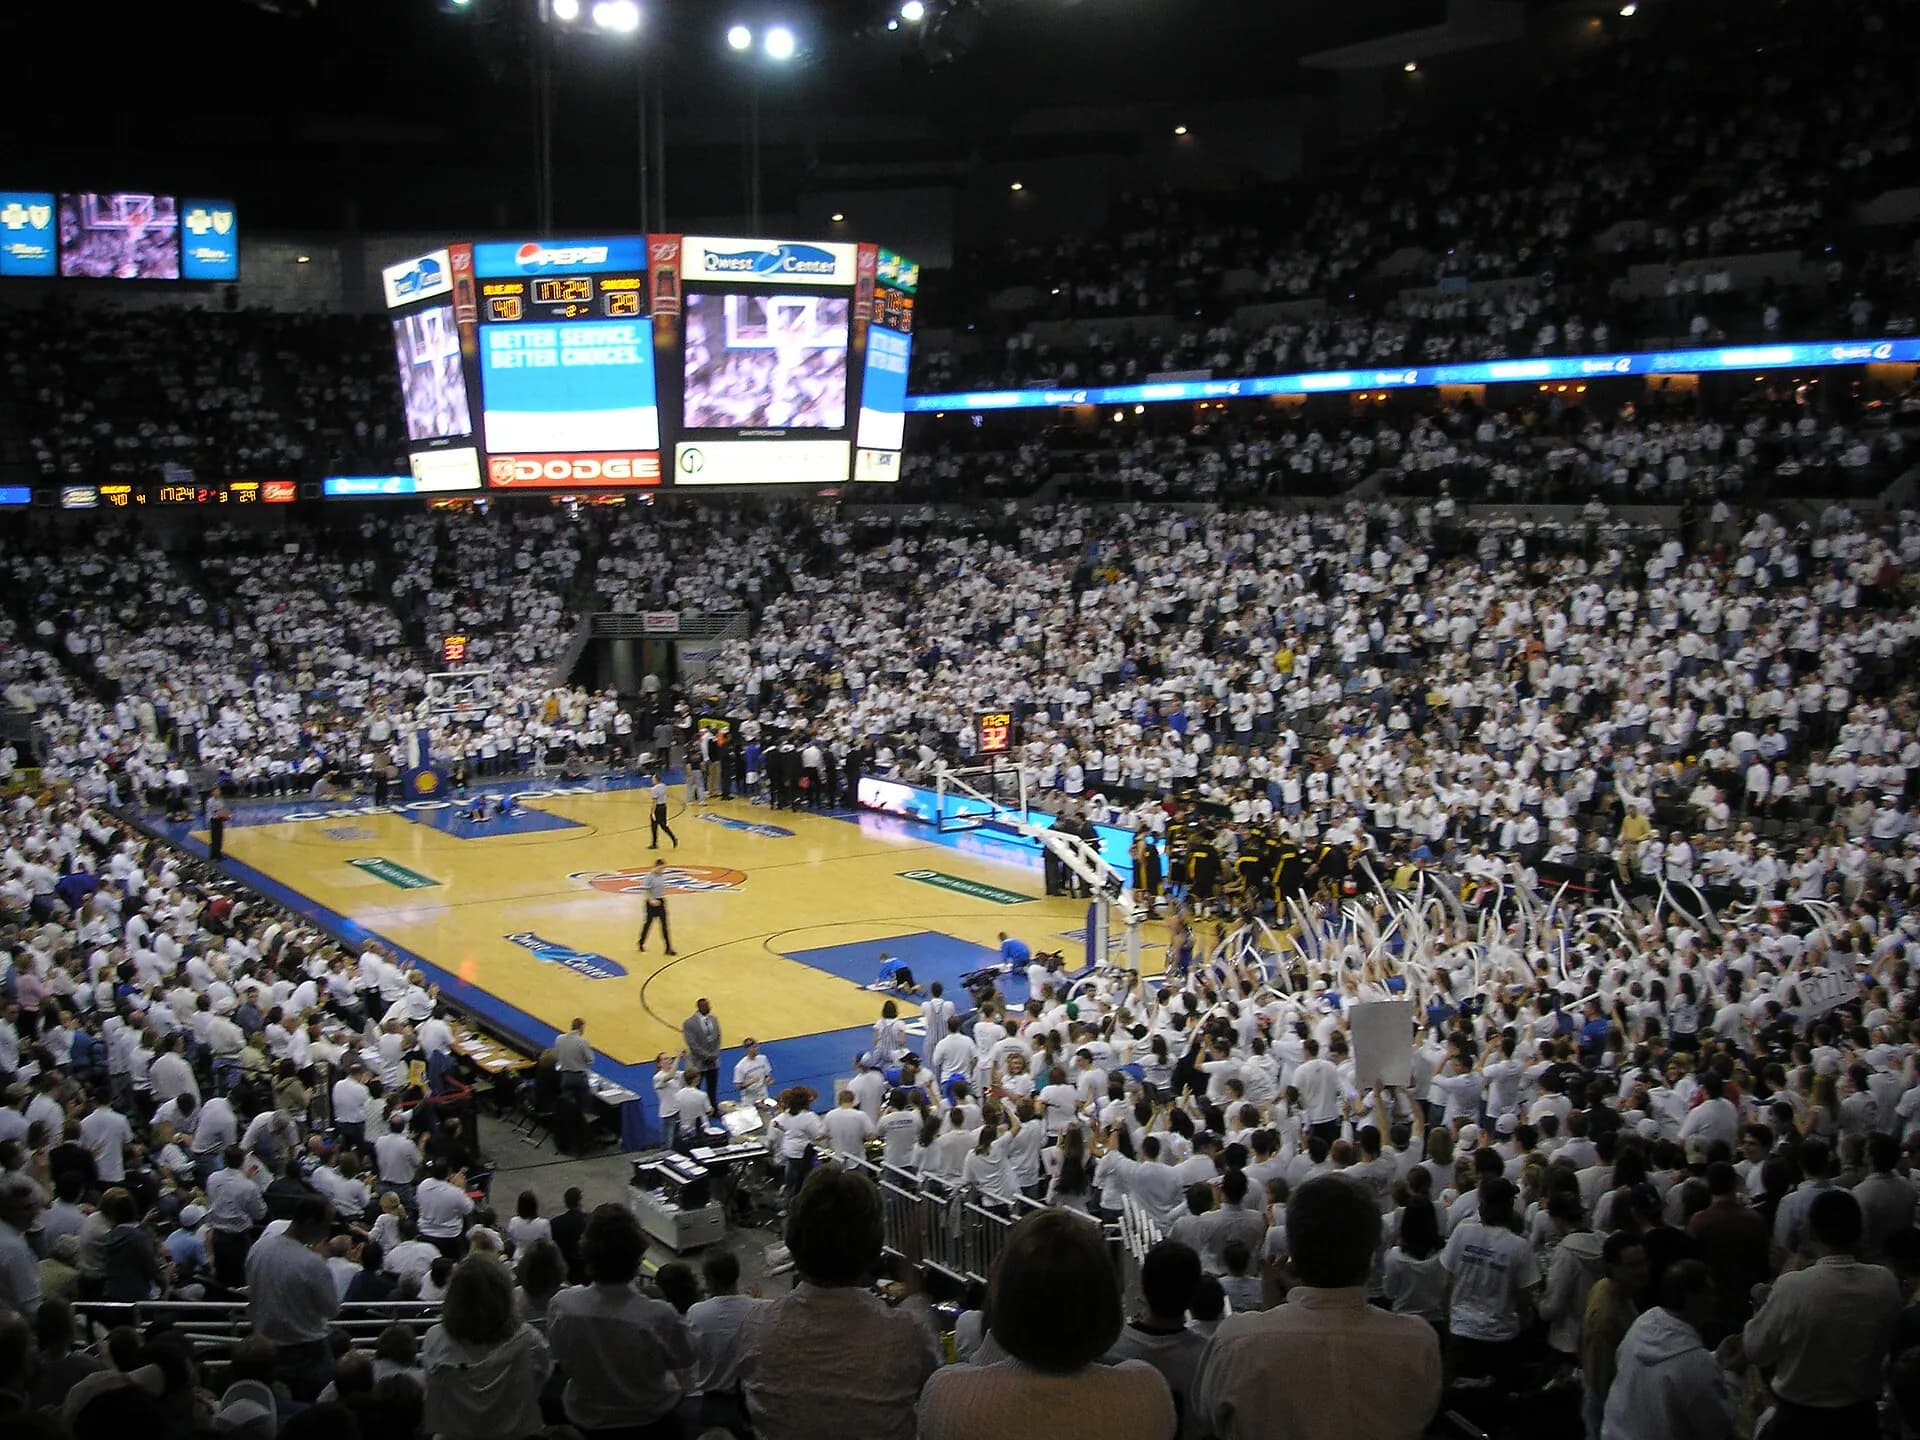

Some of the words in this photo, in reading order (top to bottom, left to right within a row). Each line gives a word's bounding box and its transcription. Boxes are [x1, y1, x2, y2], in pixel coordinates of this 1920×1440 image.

[704, 253, 753, 271] Qwest
[783, 256, 835, 273] Center
[490, 330, 556, 349] BETTER
[490, 349, 558, 369] BETTER
[514, 458, 659, 480] DODGE
